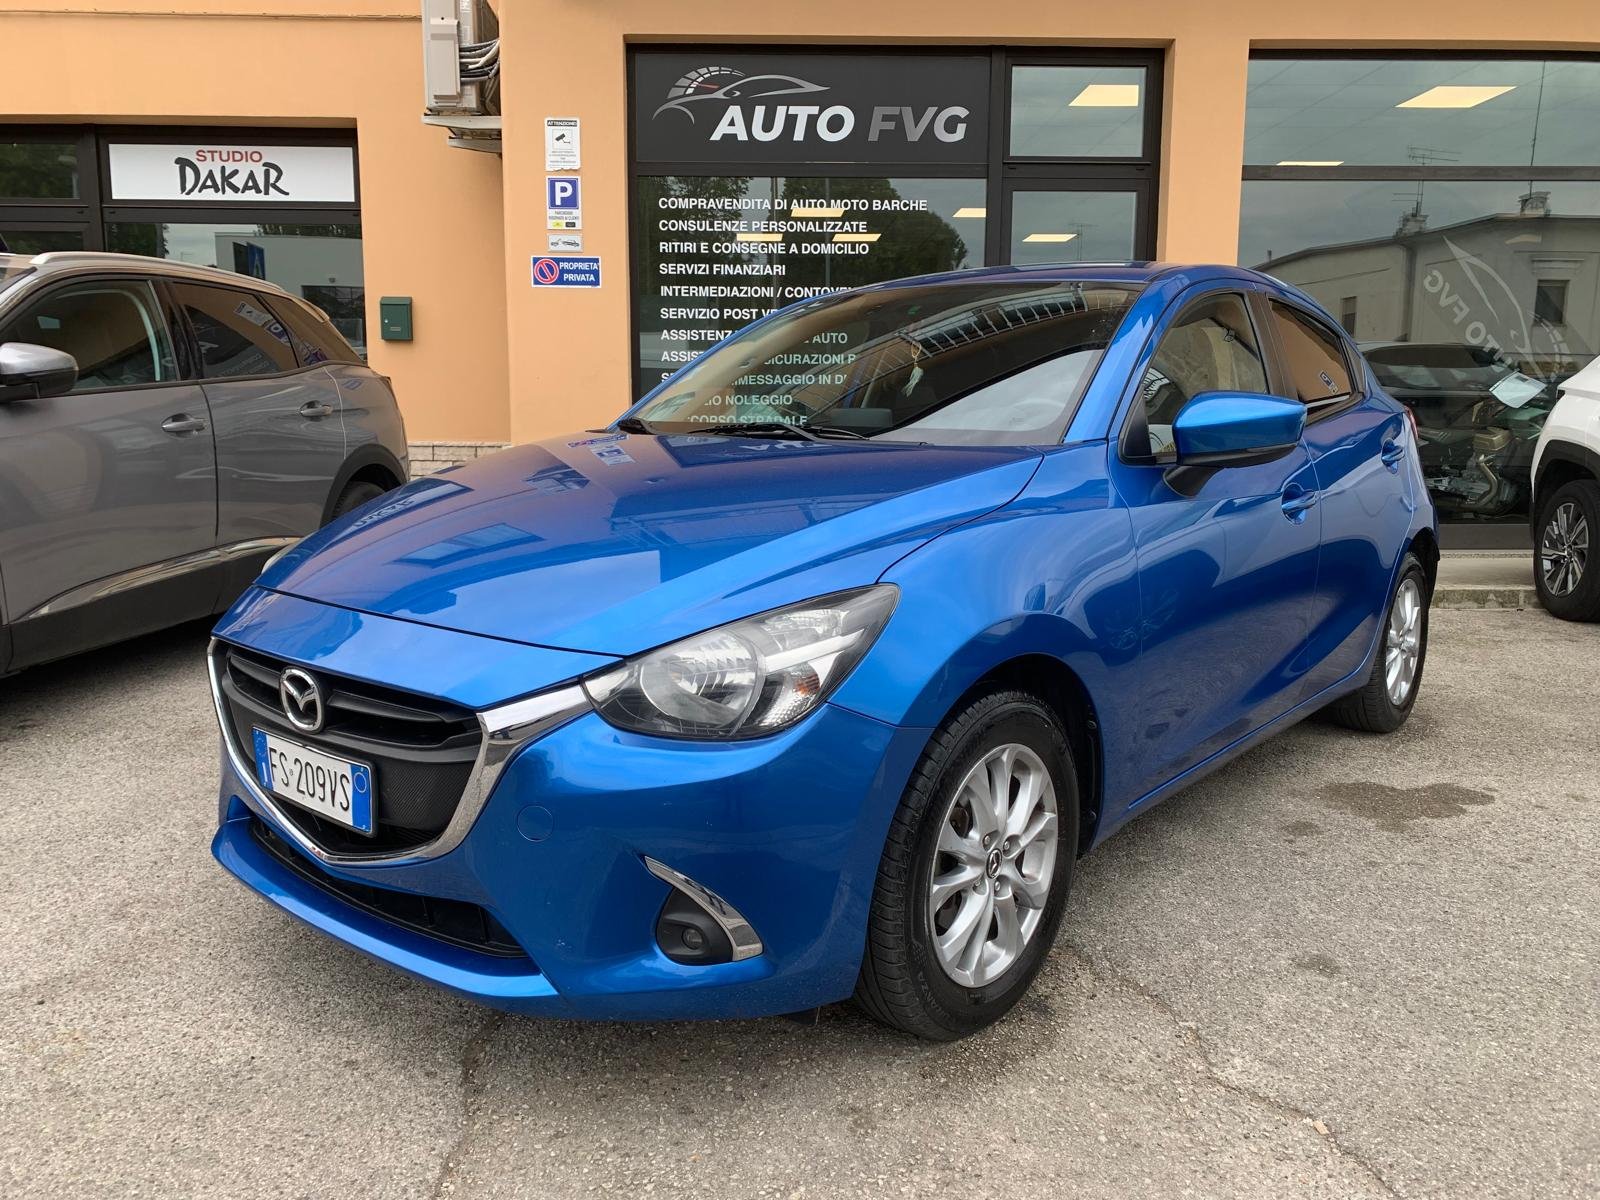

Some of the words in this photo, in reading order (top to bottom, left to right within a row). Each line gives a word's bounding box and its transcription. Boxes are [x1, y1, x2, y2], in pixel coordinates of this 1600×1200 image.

[709, 105, 855, 142] AUTO
[867, 105, 970, 143] FVG
[195, 149, 263, 163] STUDIO
[174, 156, 290, 196] DAKAR
[554, 181, 573, 206] P
[658, 197, 771, 210] COMPRAVENDITA
[774, 198, 787, 210] DI
[790, 198, 827, 210] AUTO
[830, 199, 868, 211] MOTO
[872, 199, 928, 211] BARCHE
[658, 219, 748, 232] CONSULENZE
[751, 220, 868, 233] PERSONALIZZATE
[659, 241, 697, 253] RITIRI
[700, 242, 709, 253] E
[712, 242, 786, 254] CONSEGNE
[789, 243, 799, 254] A
[801, 243, 869, 255] DOMICILIO
[659, 263, 710, 275] SERVIZI
[713, 263, 786, 276] FINANZIARI
[563, 273, 595, 282] PRIVATA
[660, 285, 774, 298] INTERMEDIAZIONI
[776, 286, 783, 298] /
[660, 307, 720, 320] SERVIZIO
[723, 308, 758, 320] POST
[812, 332, 848, 344] AUTO
[818, 374, 831, 385] IN
[725, 394, 793, 405] NOLEGGIO
